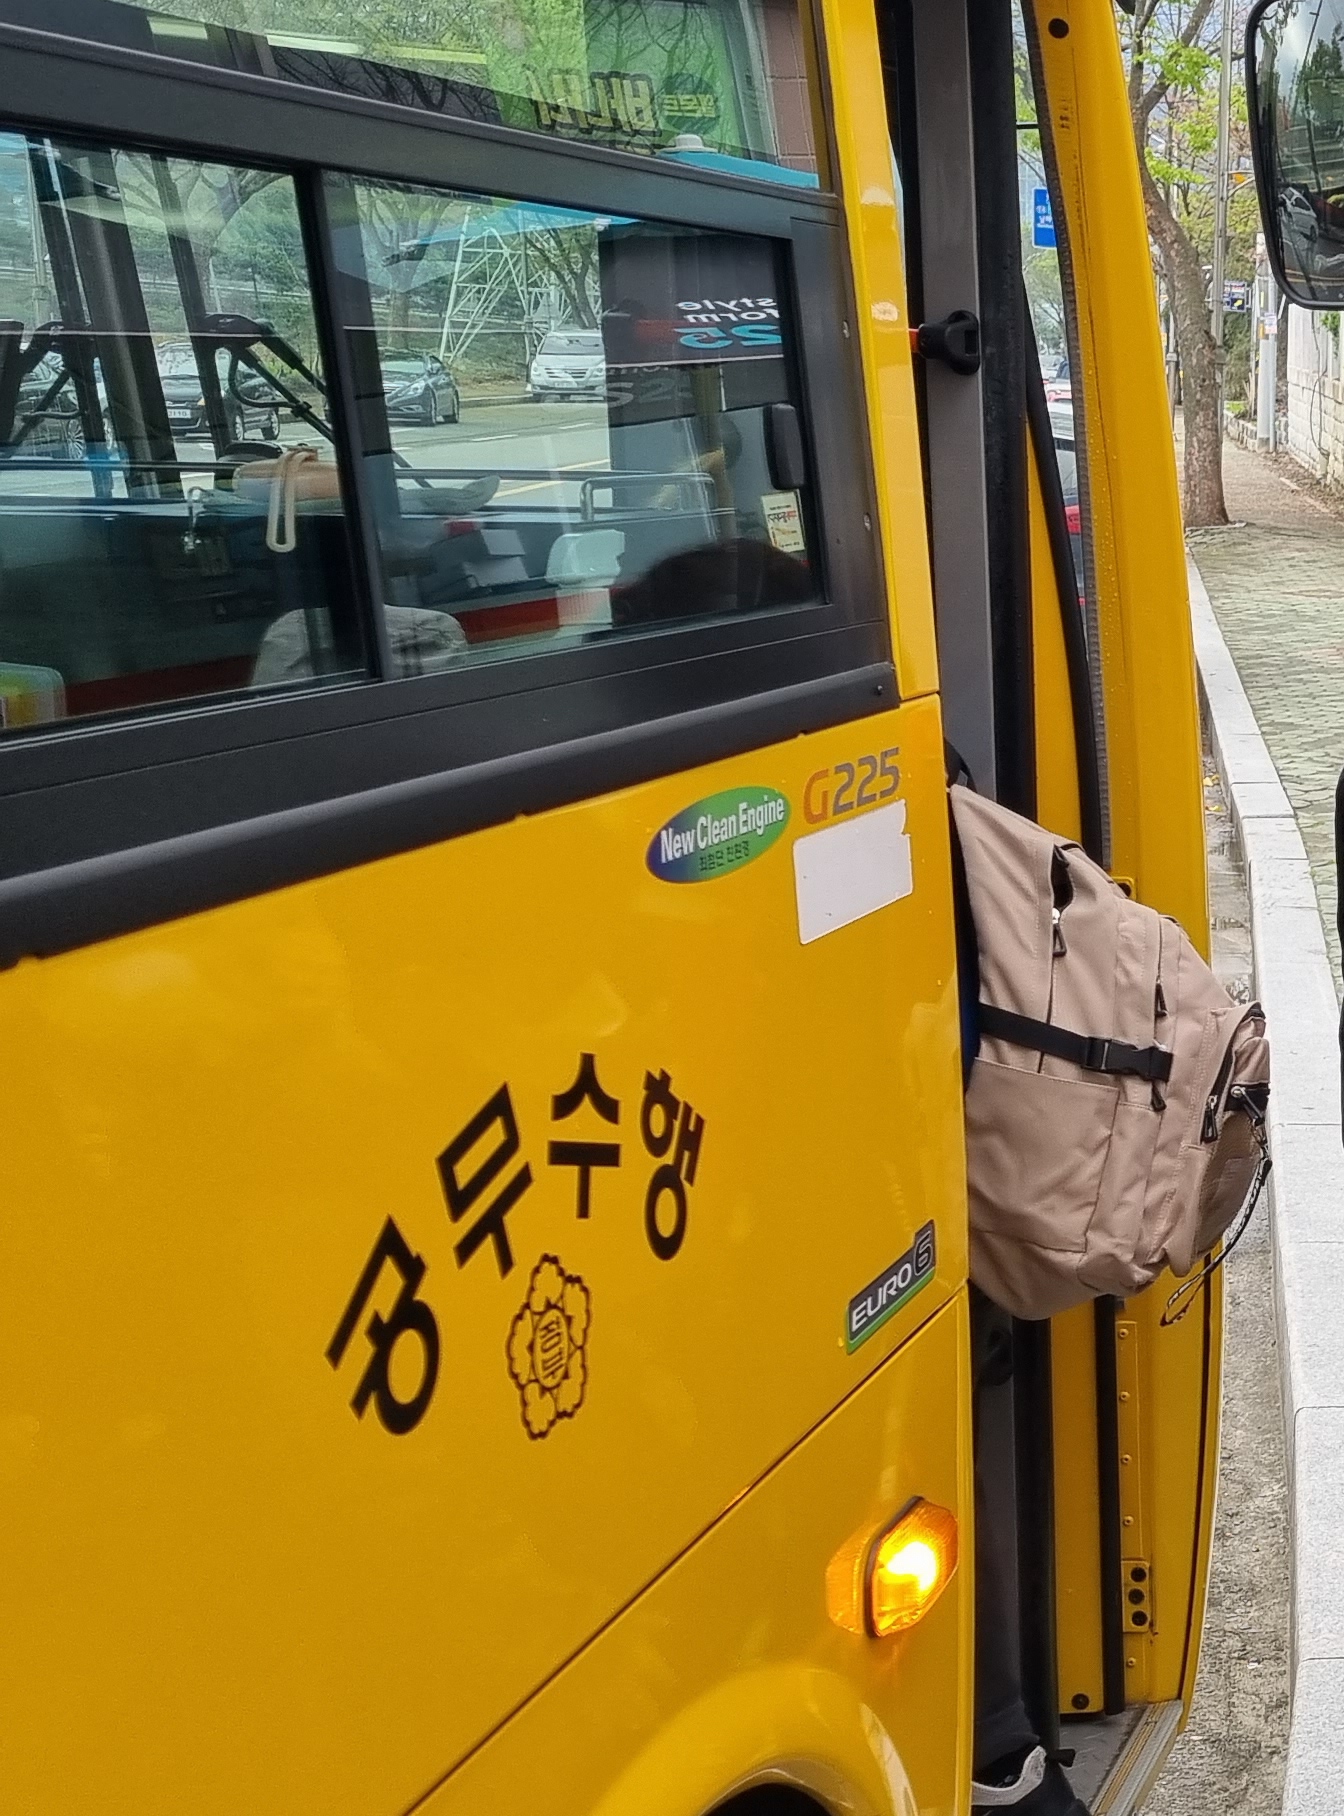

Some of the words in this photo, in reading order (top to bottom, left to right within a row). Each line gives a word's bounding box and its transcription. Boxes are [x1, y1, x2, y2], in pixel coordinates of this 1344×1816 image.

[803, 747, 900, 824] G225
[660, 826, 696, 863] New
[696, 814, 737, 850] Clean
[738, 795, 784, 836] Engine
[324, 1052, 706, 1436] 공무수행
